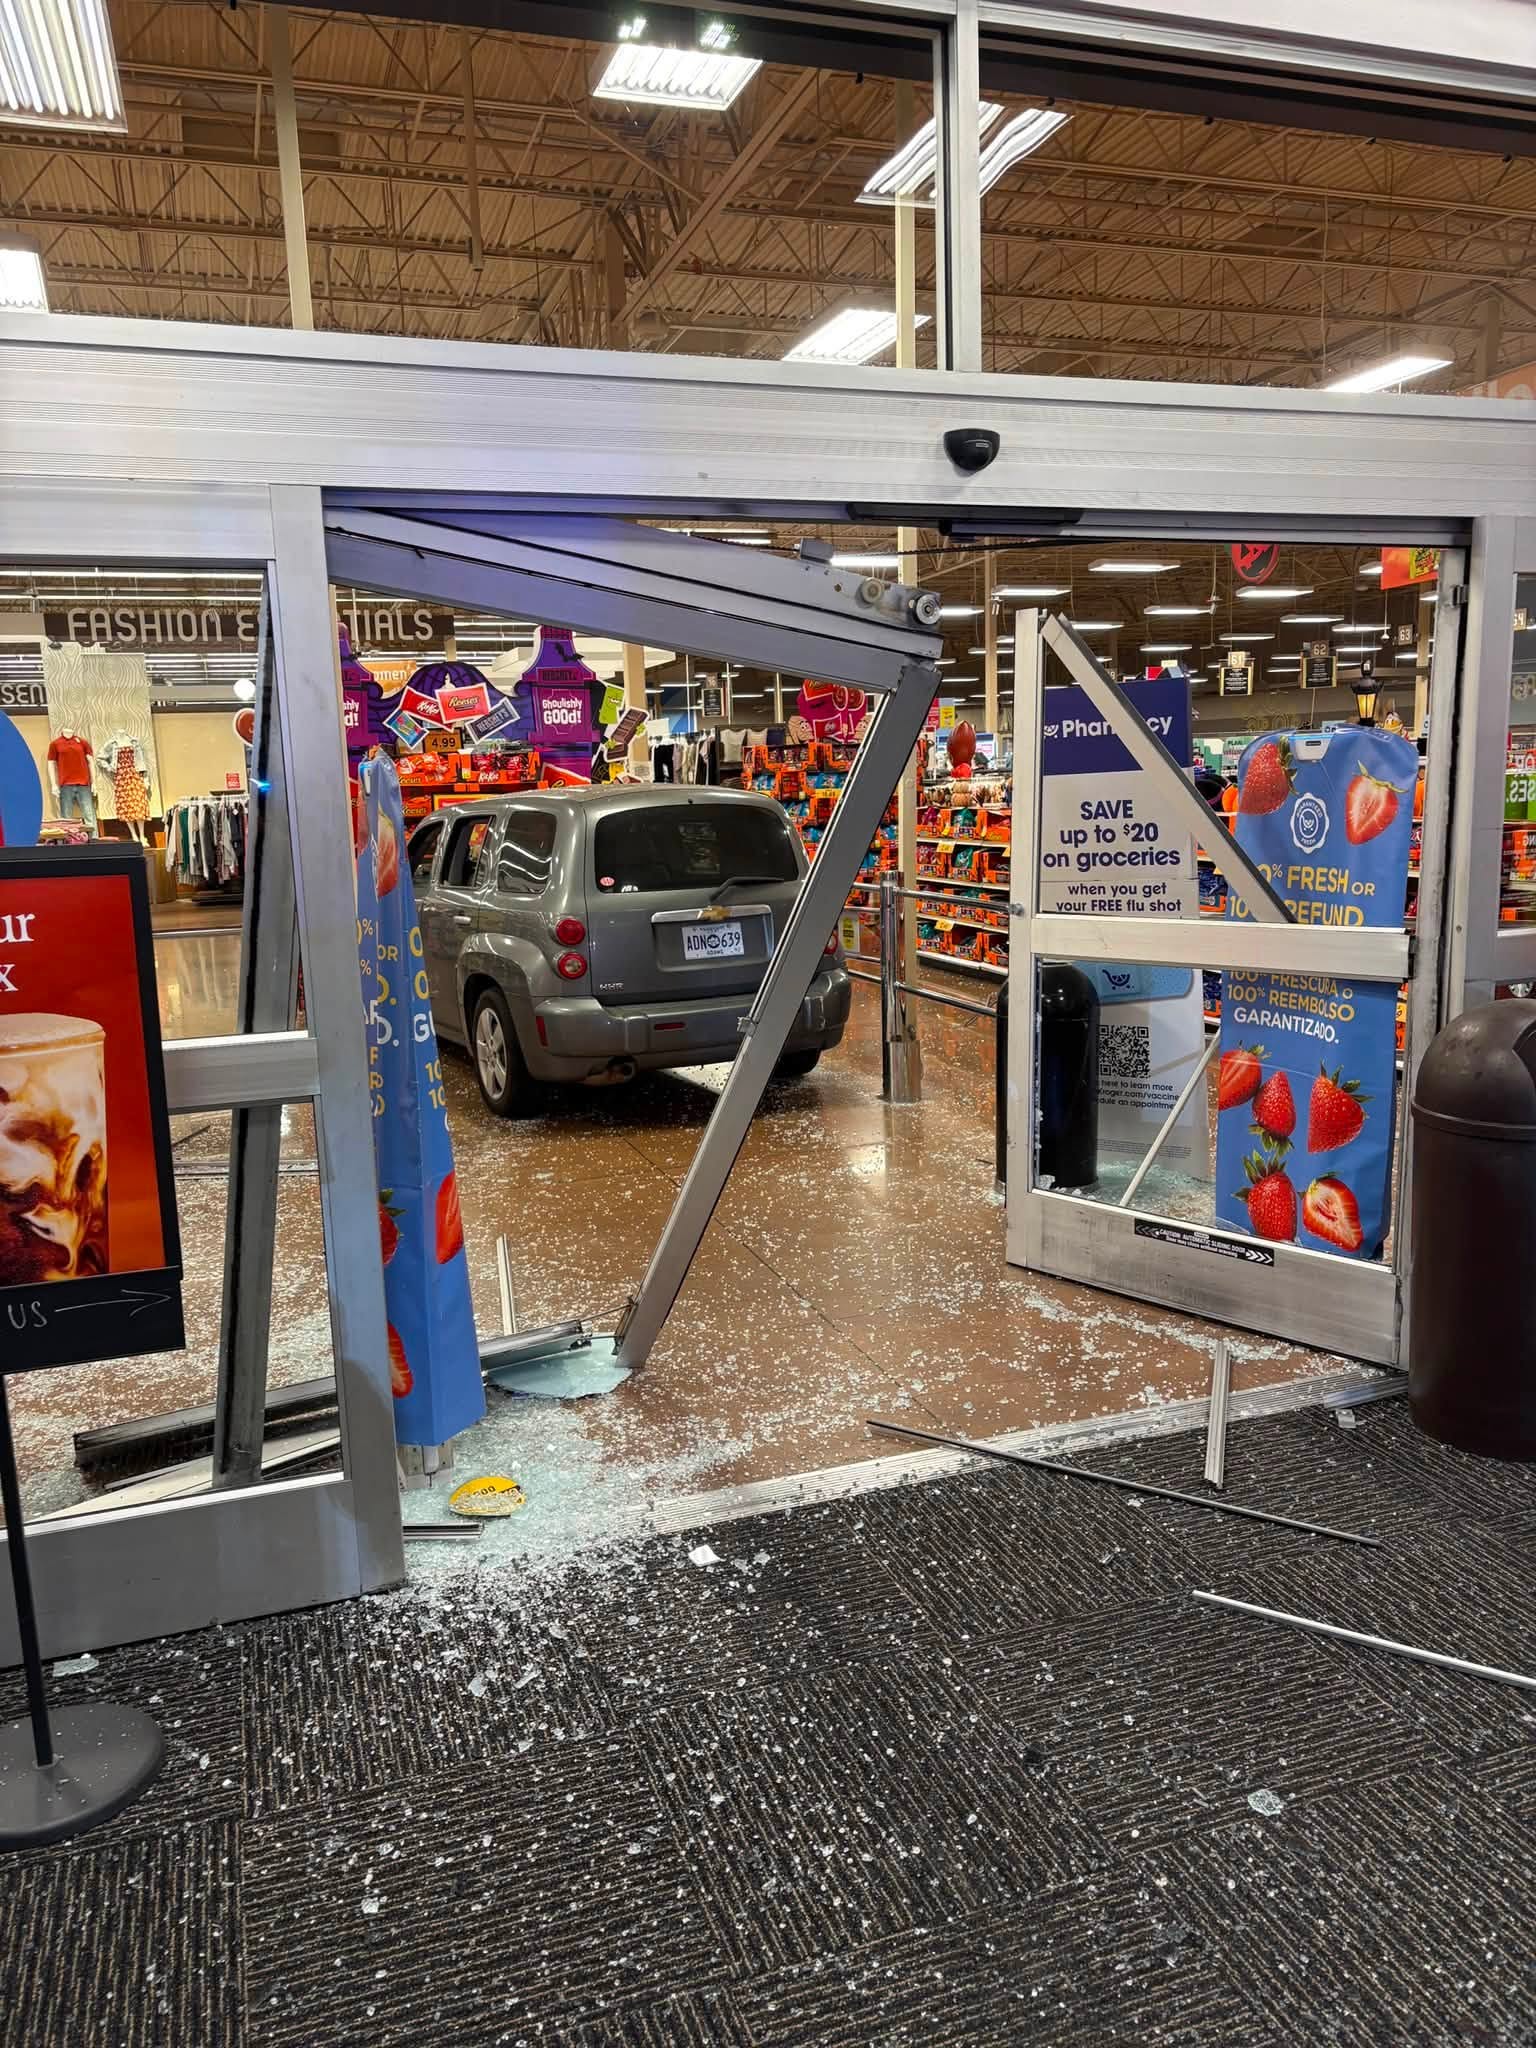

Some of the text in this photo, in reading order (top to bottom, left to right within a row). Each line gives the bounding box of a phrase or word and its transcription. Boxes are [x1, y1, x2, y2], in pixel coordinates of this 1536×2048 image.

[67, 607, 223, 643] FASHION
[1400, 628, 1411, 640] 63
[1313, 643, 1326, 655] 62
[1062, 715, 1173, 738] Pharcy
[431, 738, 456, 748] 4.99
[1080, 800, 1134, 820] SAVE
[1060, 822, 1159, 848] up to $20
[1043, 846, 1181, 872] on groceries
[1068, 882, 1167, 898] when you get
[1286, 865, 1349, 895] FRESH
[1351, 881, 1376, 897] OR
[1056, 899, 1182, 912] your FREE flu shot
[0, 908, 36, 943] ur
[687, 931, 741, 951] ADN 639
[1270, 973, 1339, 998] FRESCURA
[1227, 983, 1356, 1023] 100% REEMBOLSO
[1233, 1006, 1341, 1045] GARANTIZADO.
[1120, 1080, 1129, 1089] to
[1130, 1080, 1150, 1090] learn
[1152, 1083, 1174, 1092] more
[1130, 1099, 1175, 1110] appointme
[1231, 1244, 1246, 1253] DOOR
[7, 1300, 48, 1329] US
